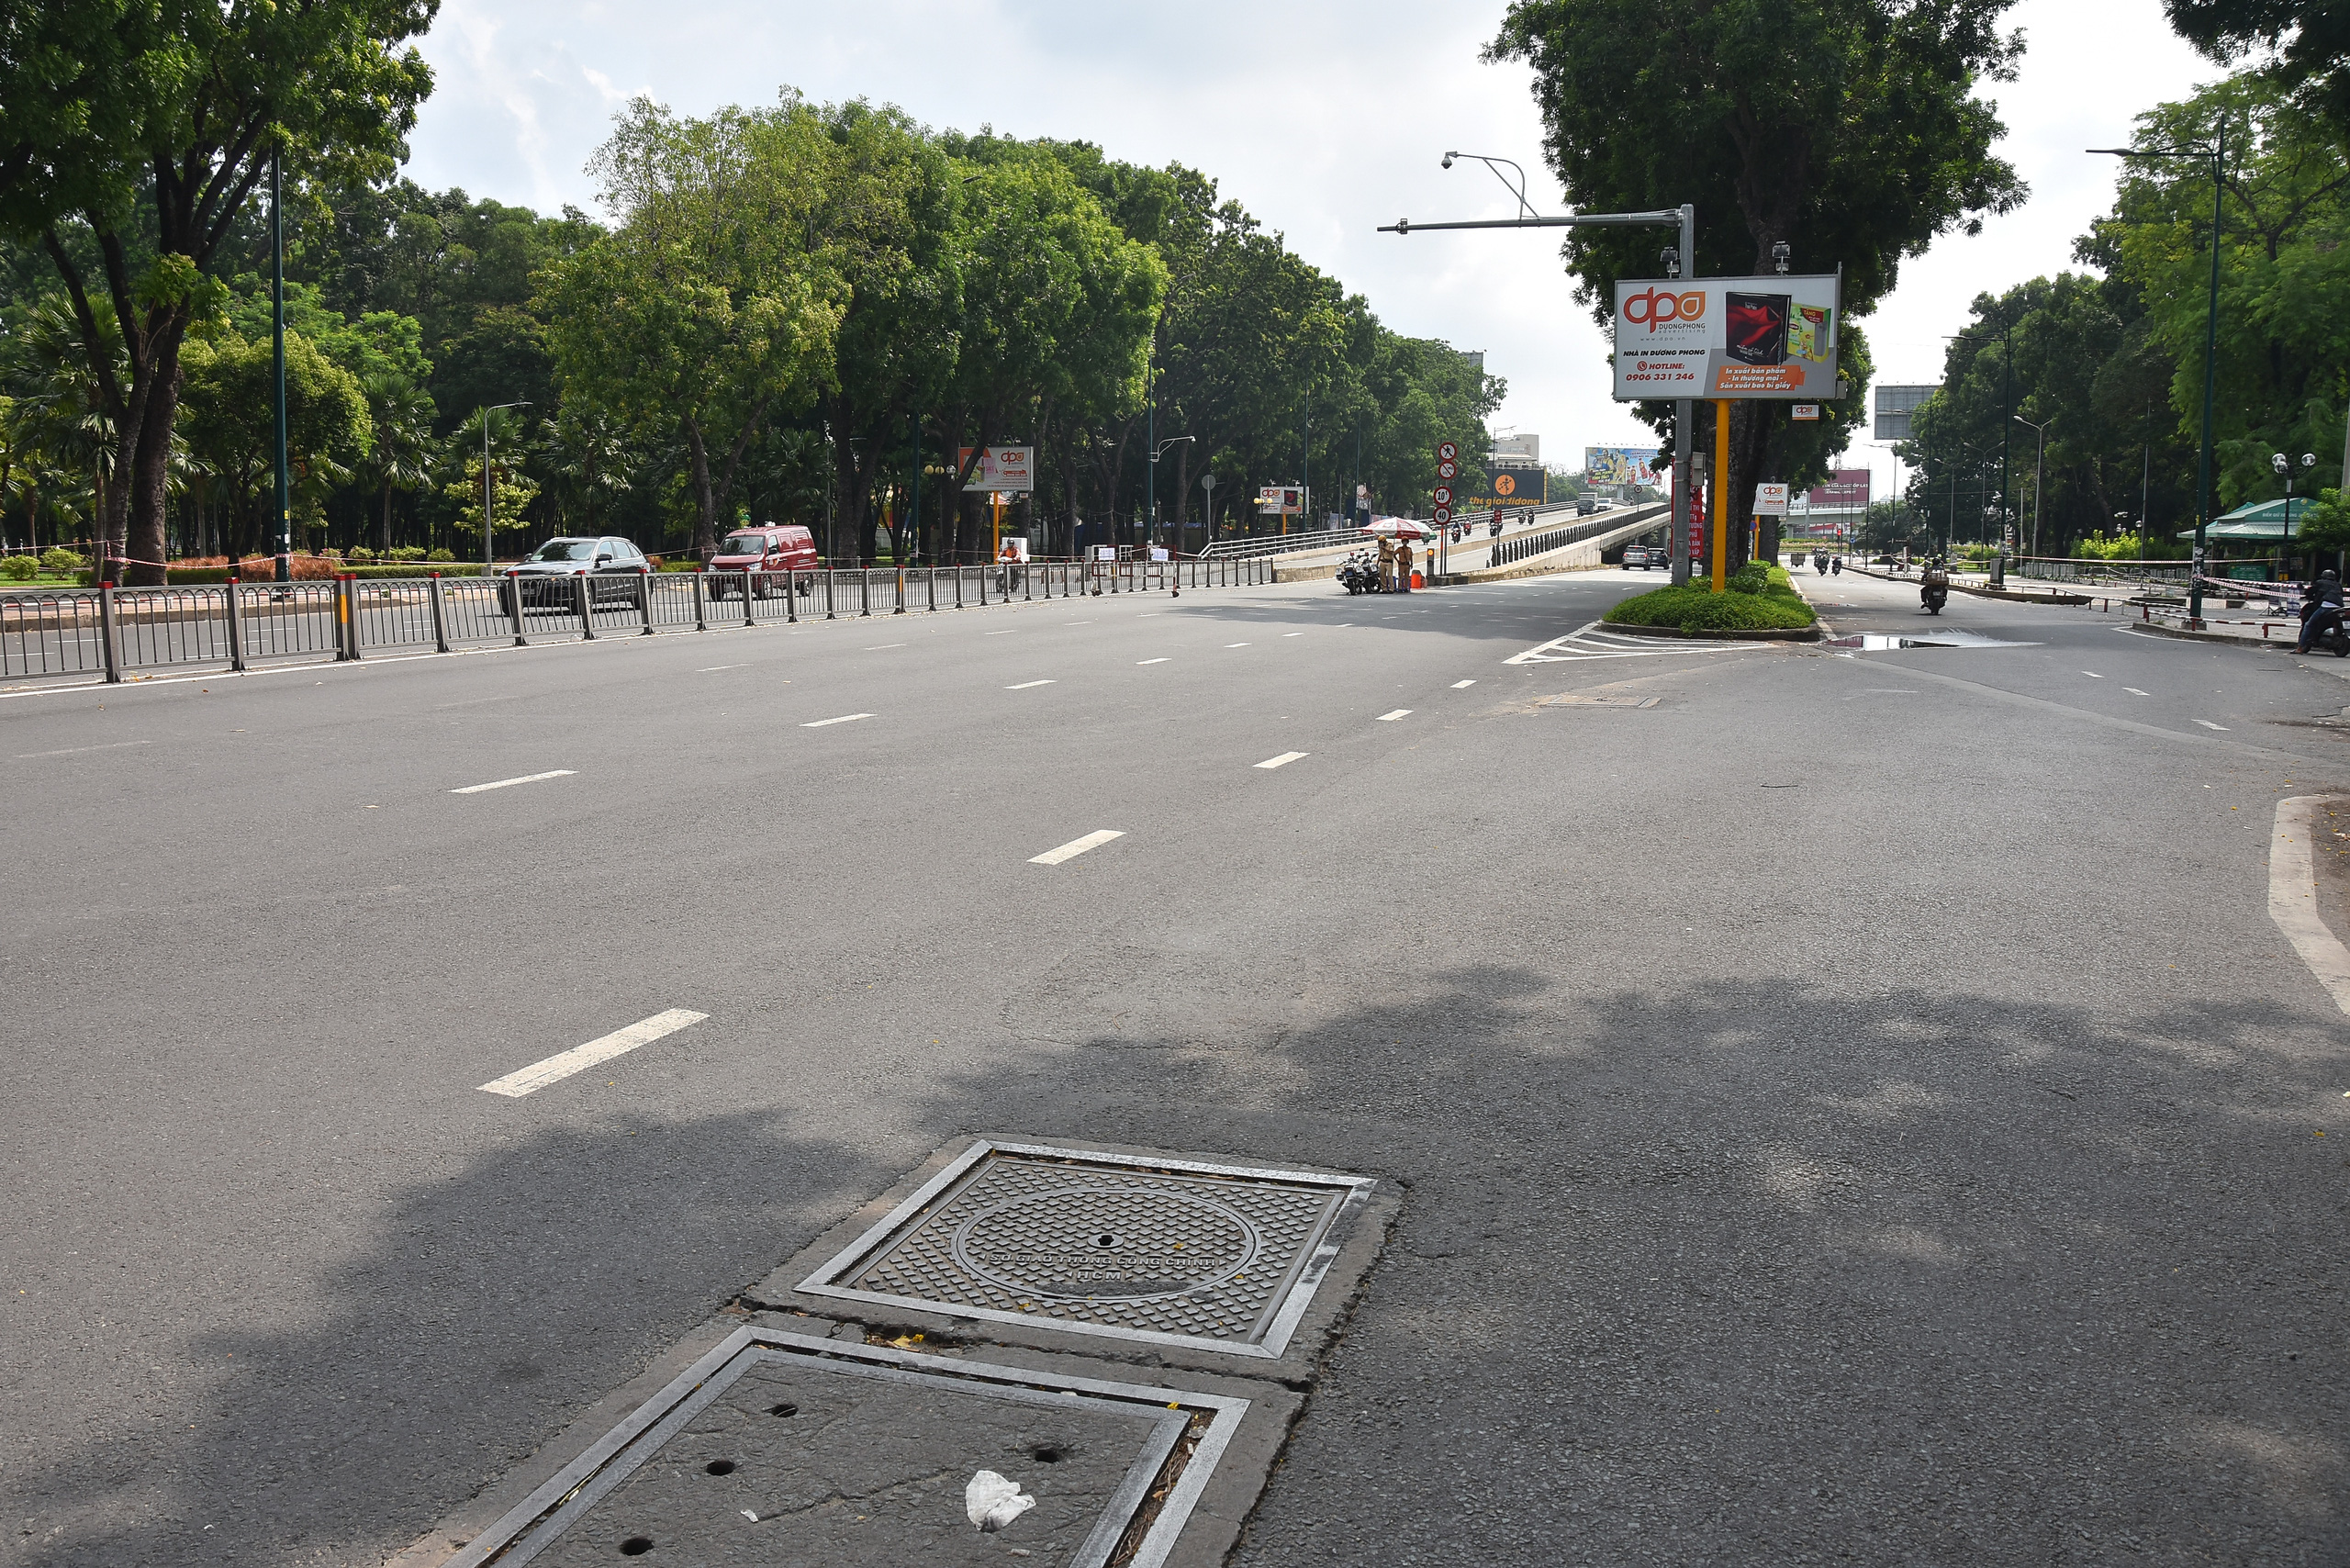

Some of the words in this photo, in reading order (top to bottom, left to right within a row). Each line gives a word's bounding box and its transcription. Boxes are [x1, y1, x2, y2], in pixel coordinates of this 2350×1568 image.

[1469, 496, 1540, 507] thegioididong
[1437, 511, 1446, 520] 40
[1117, 1256, 1160, 1266] CÔNG
[1077, 1271, 1121, 1281] HCM
